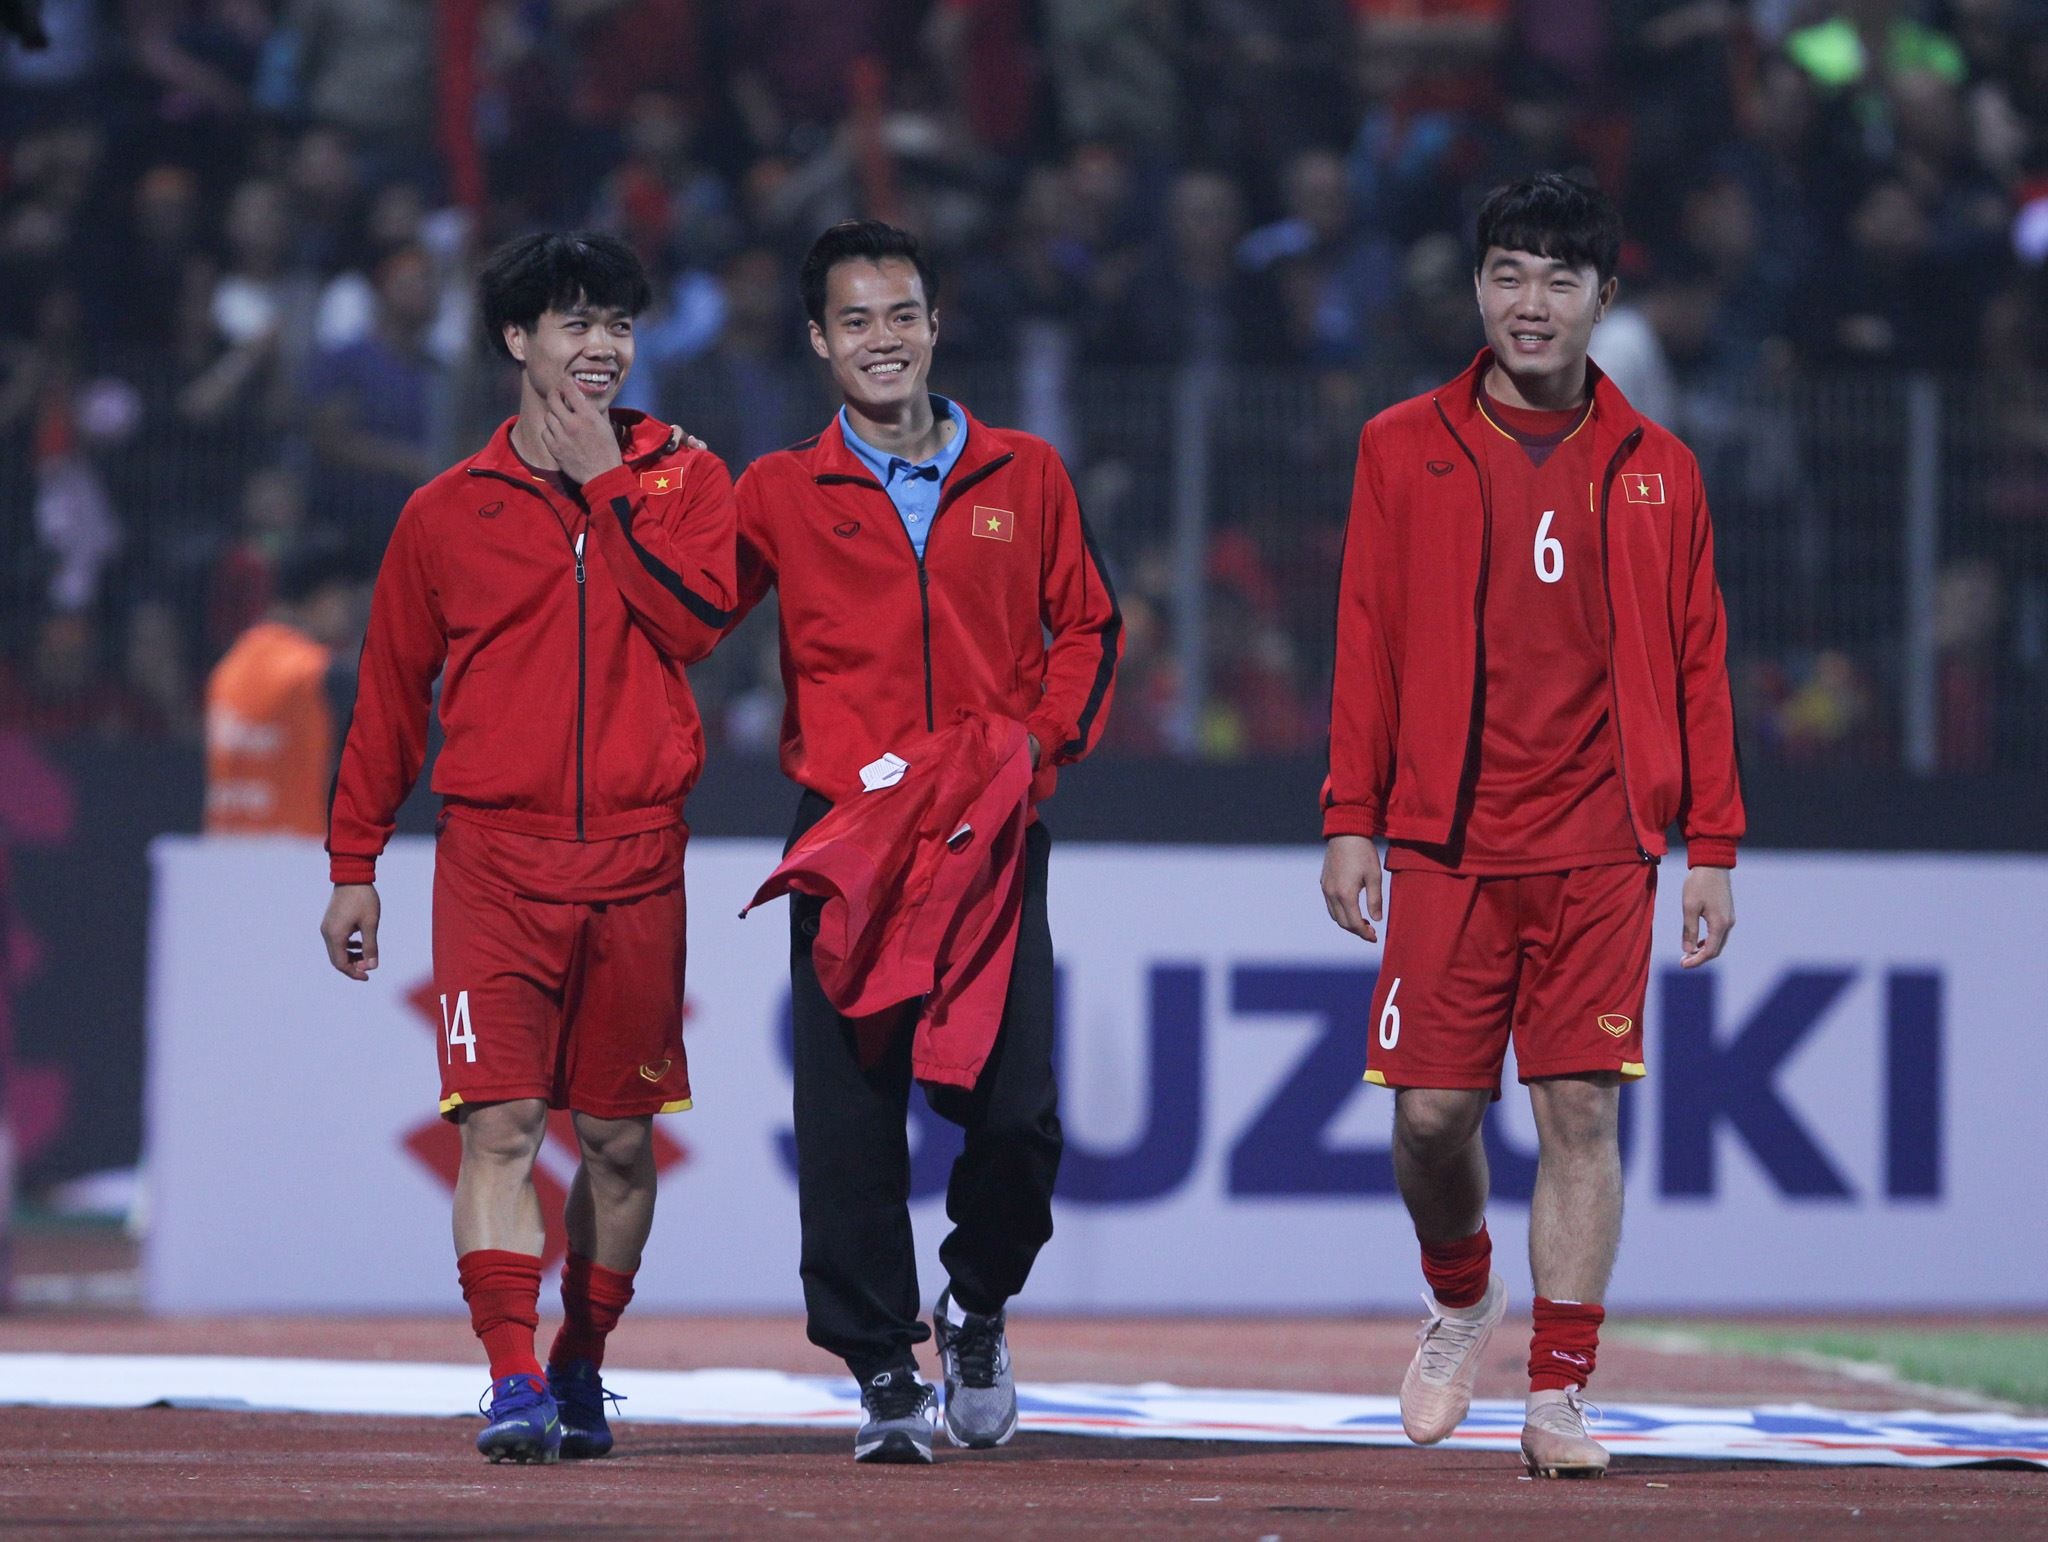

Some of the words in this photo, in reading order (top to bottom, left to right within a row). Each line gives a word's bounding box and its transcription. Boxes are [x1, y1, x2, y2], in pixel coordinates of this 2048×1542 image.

[1534, 510, 1564, 583] 6
[440, 990, 476, 1065] 14
[1378, 977, 1400, 1050] 6
[773, 964, 1945, 1206] UZKI
